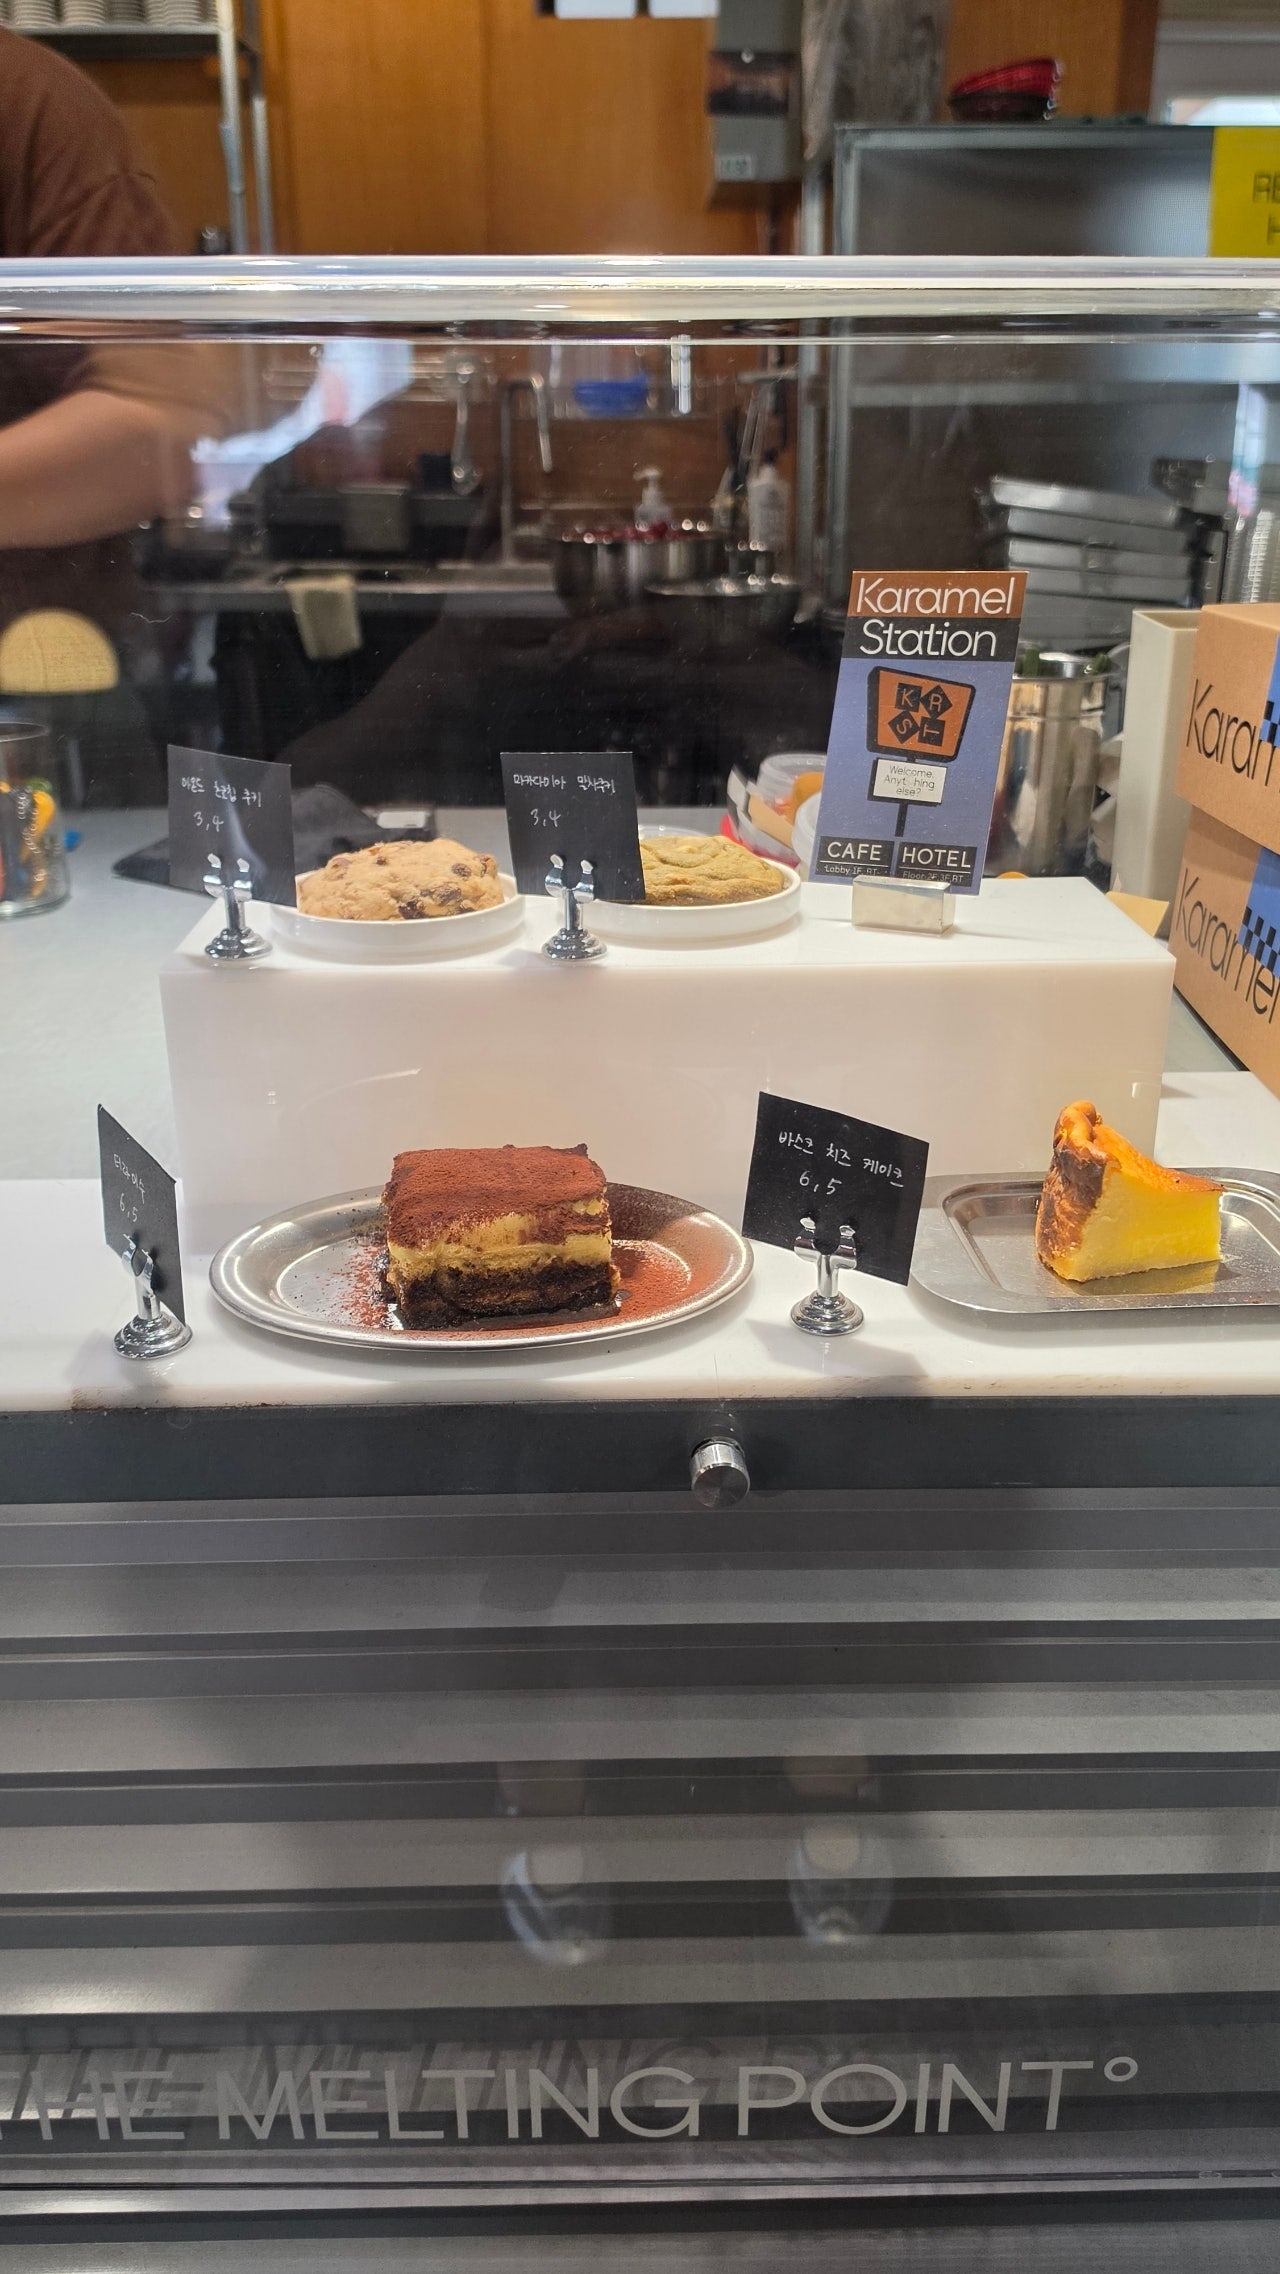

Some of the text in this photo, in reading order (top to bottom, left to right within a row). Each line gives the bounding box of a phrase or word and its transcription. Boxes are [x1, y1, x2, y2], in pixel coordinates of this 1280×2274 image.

[856, 576, 1015, 615] Karamel
[860, 618, 997, 657] Station
[513, 774, 566, 789] 마카다미아
[896, 786, 922, 798] else?
[242, 788, 261, 808] 쿠키
[827, 841, 882, 861] CAFE
[902, 846, 971, 868] HOTEL
[779, 1131, 904, 1187] 바스크 치즈 케이크
[113, 1153, 146, 1205] 티라미수
[216, 2066, 699, 2140] MELTING
